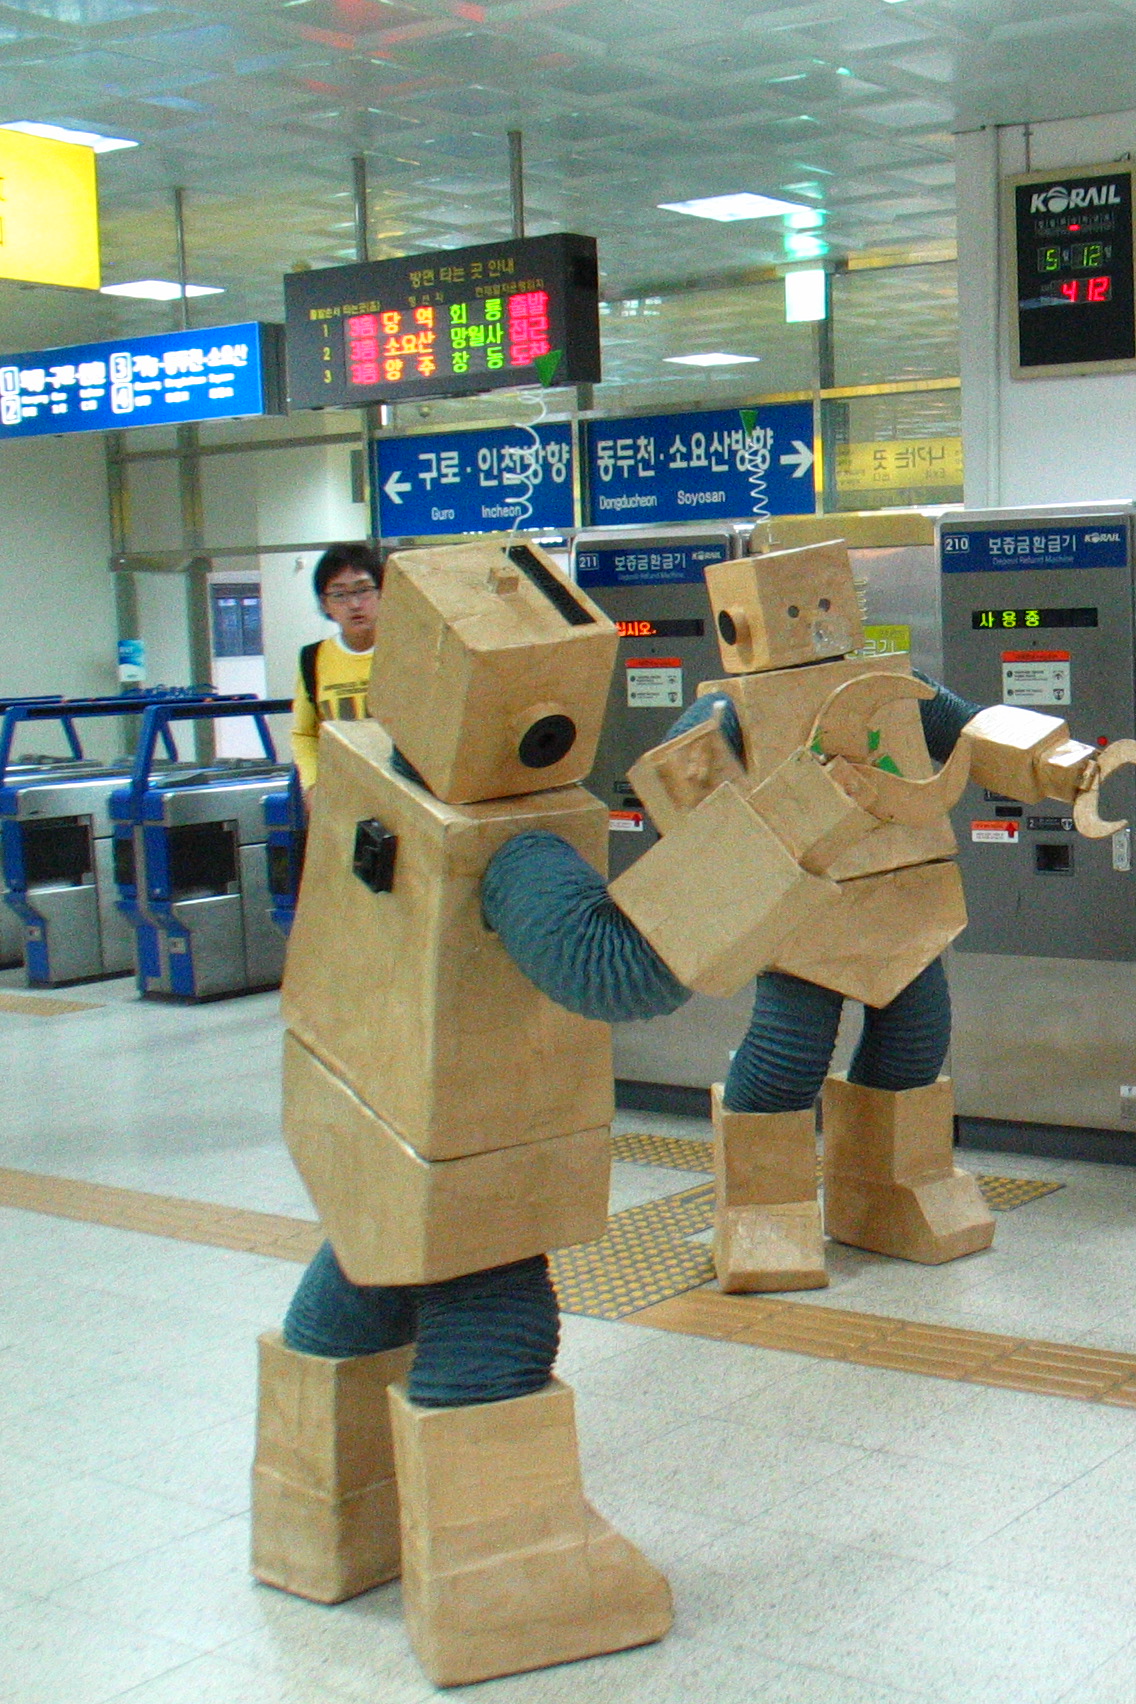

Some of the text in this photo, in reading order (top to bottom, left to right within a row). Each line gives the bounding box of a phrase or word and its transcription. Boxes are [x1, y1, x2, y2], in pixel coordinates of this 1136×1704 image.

[1030, 184, 1121, 214] KORAIL
[1045, 245, 1101, 271] 5 12
[439, 266, 465, 283] 타는
[487, 257, 515, 277] 안내
[323, 323, 329, 338] 1
[323, 346, 331, 361] 2
[383, 329, 437, 356] 소요산
[450, 322, 504, 349] 망월사
[323, 369, 333, 384] 3
[599, 493, 658, 511] Dongducheon
[676, 489, 726, 507] Soyosan
[431, 504, 522, 521] Guro Incheon
[945, 532, 1121, 555] 210 보증금환급기 KORAIL
[578, 555, 597, 568] 211
[614, 552, 687, 572] 보증금환급기
